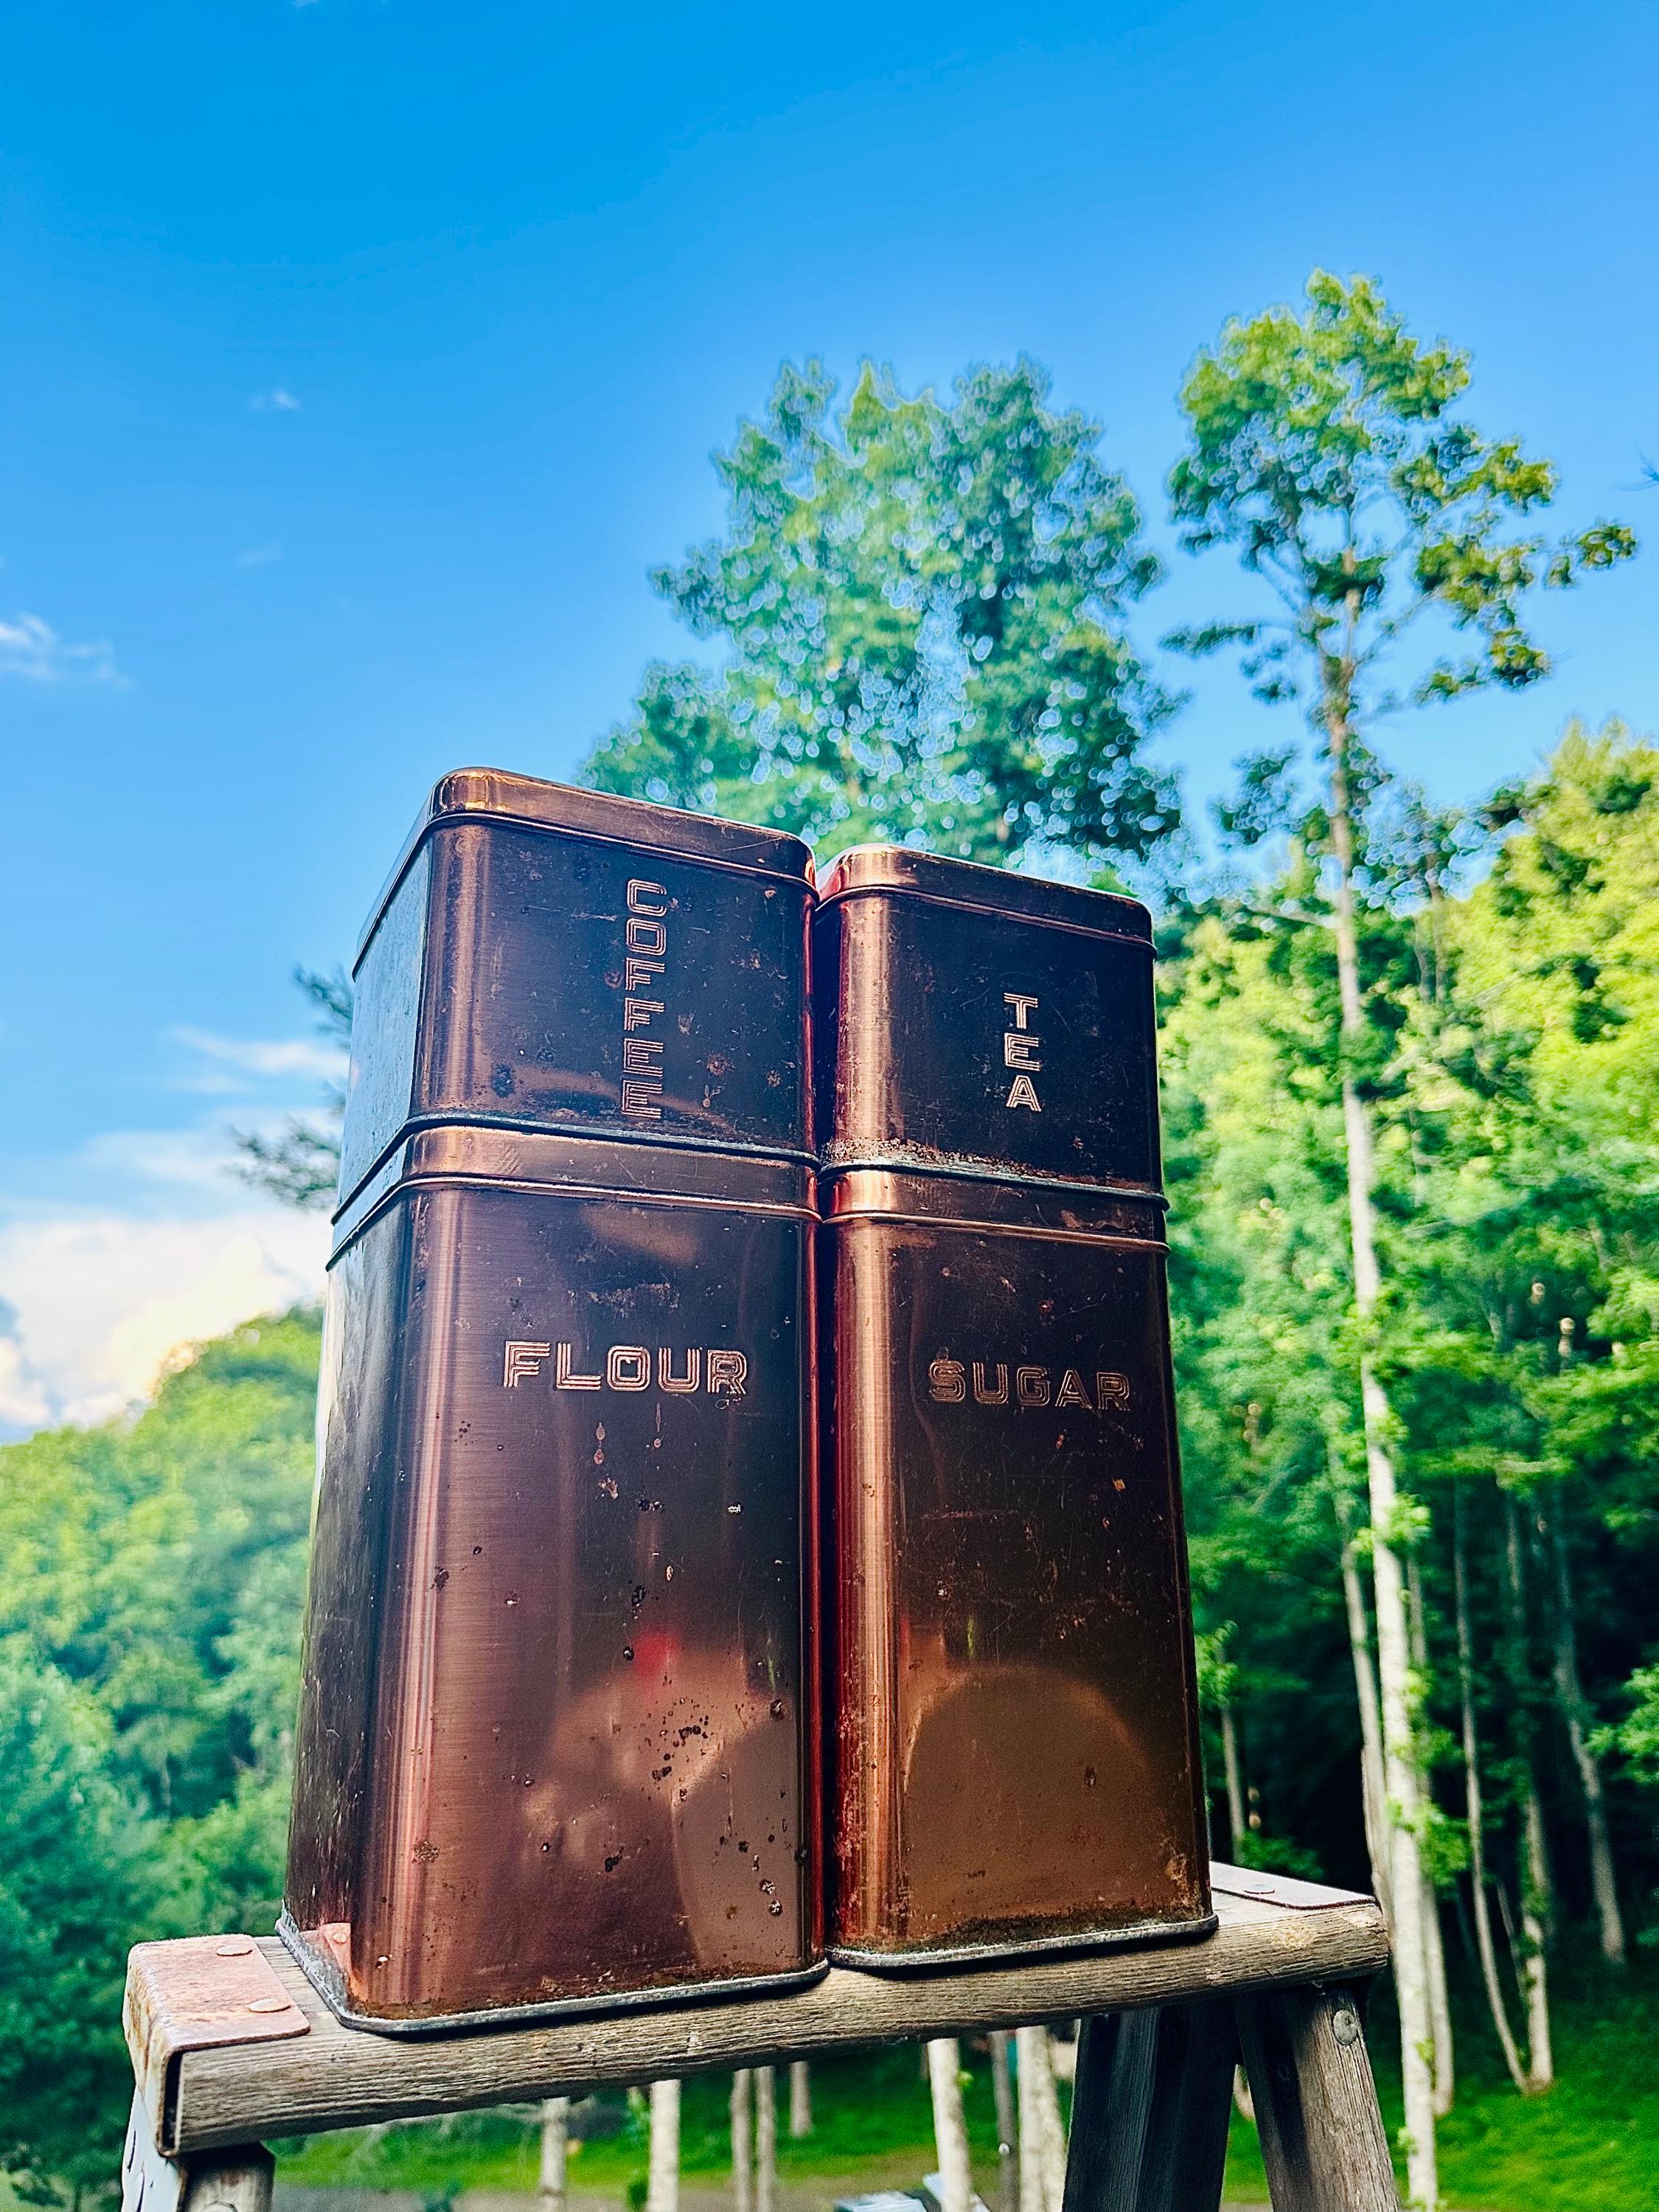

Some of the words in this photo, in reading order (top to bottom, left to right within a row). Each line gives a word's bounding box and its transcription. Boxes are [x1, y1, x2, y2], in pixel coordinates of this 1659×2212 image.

[622, 878, 667, 1119] COFFEE
[1004, 992, 1042, 1112] TEA
[504, 1340, 747, 1394] FLOUR
[928, 1360, 1130, 1411] SUGAR
